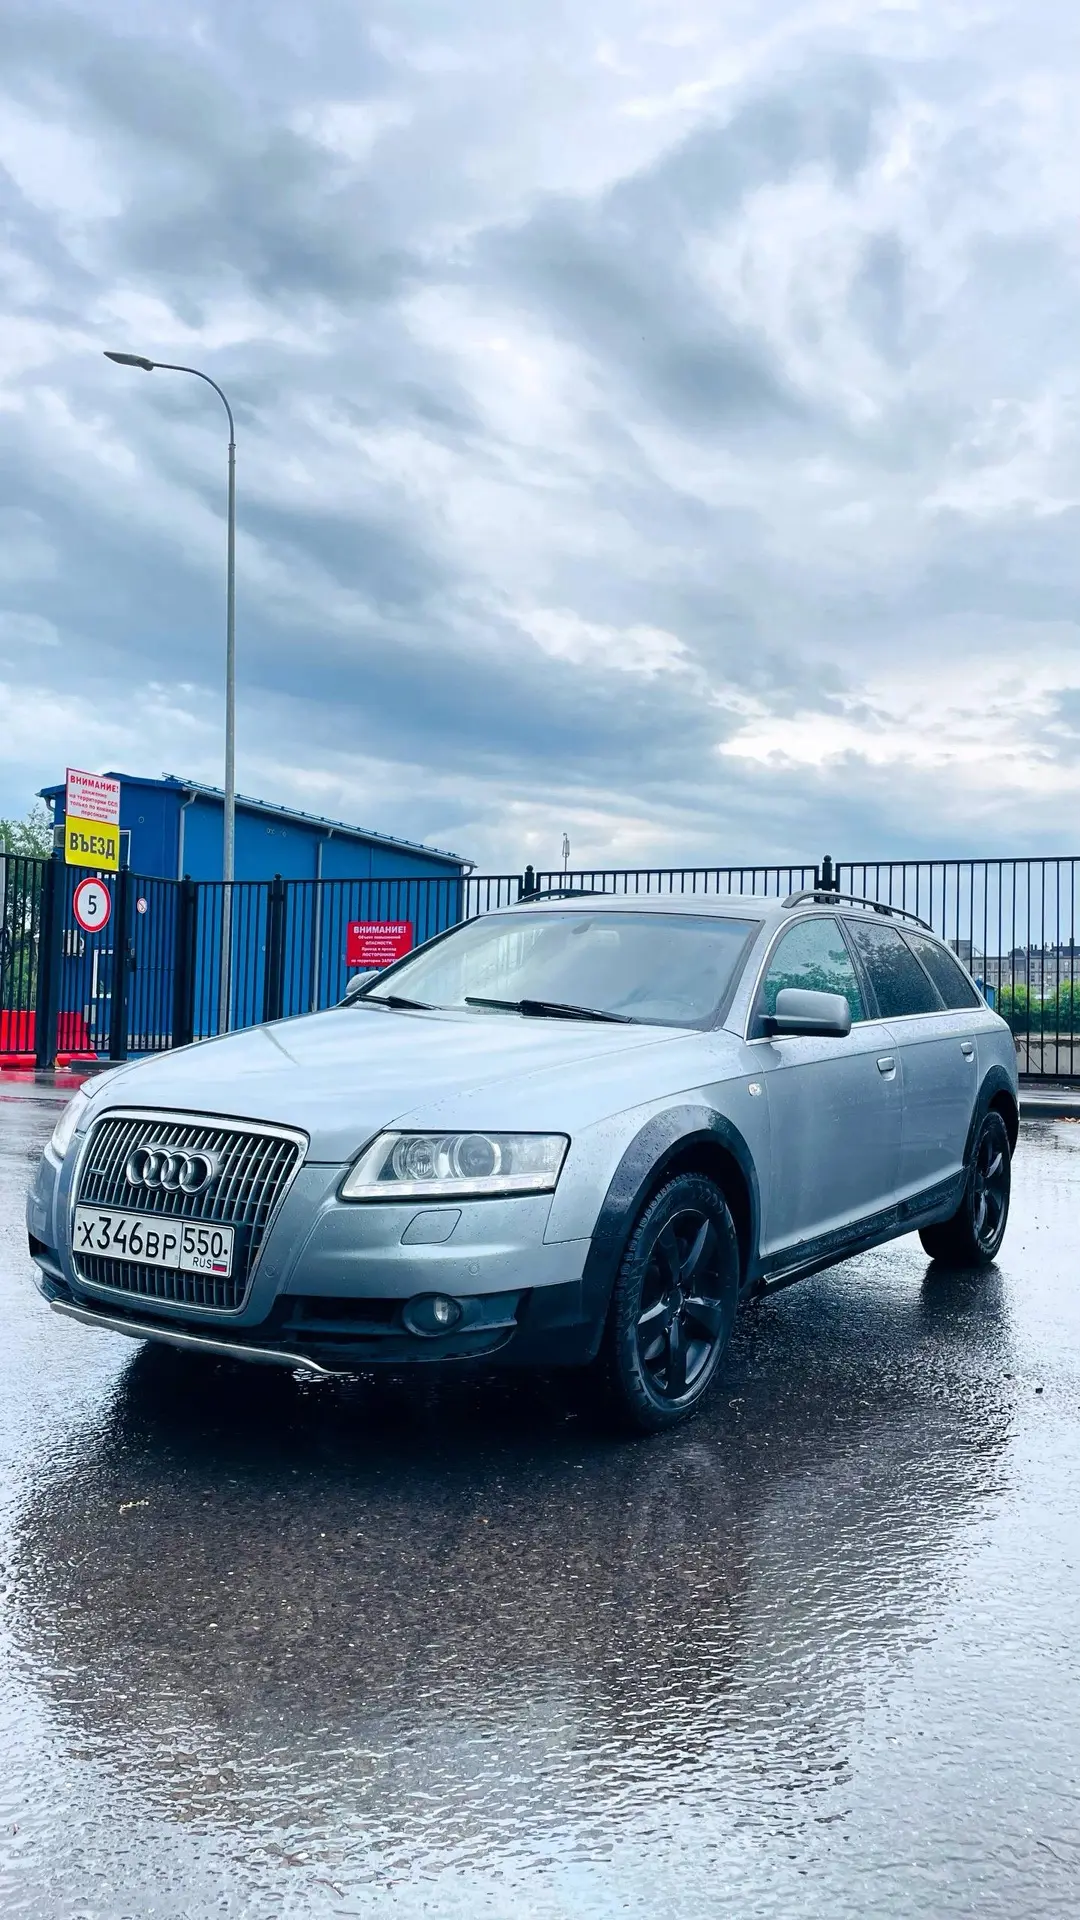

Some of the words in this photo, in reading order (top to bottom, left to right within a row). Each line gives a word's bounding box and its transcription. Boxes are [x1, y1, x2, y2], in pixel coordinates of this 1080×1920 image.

[70, 775, 119, 793] ВНИМАНИЕ!
[70, 801, 88, 809] только
[70, 832, 115, 860] ВЪЕЗД
[88, 895, 97, 915] 5
[353, 926, 406, 934] ВНИМАНИЕ!
[183, 1227, 223, 1258] 550
[192, 1256, 212, 1269] RUS
